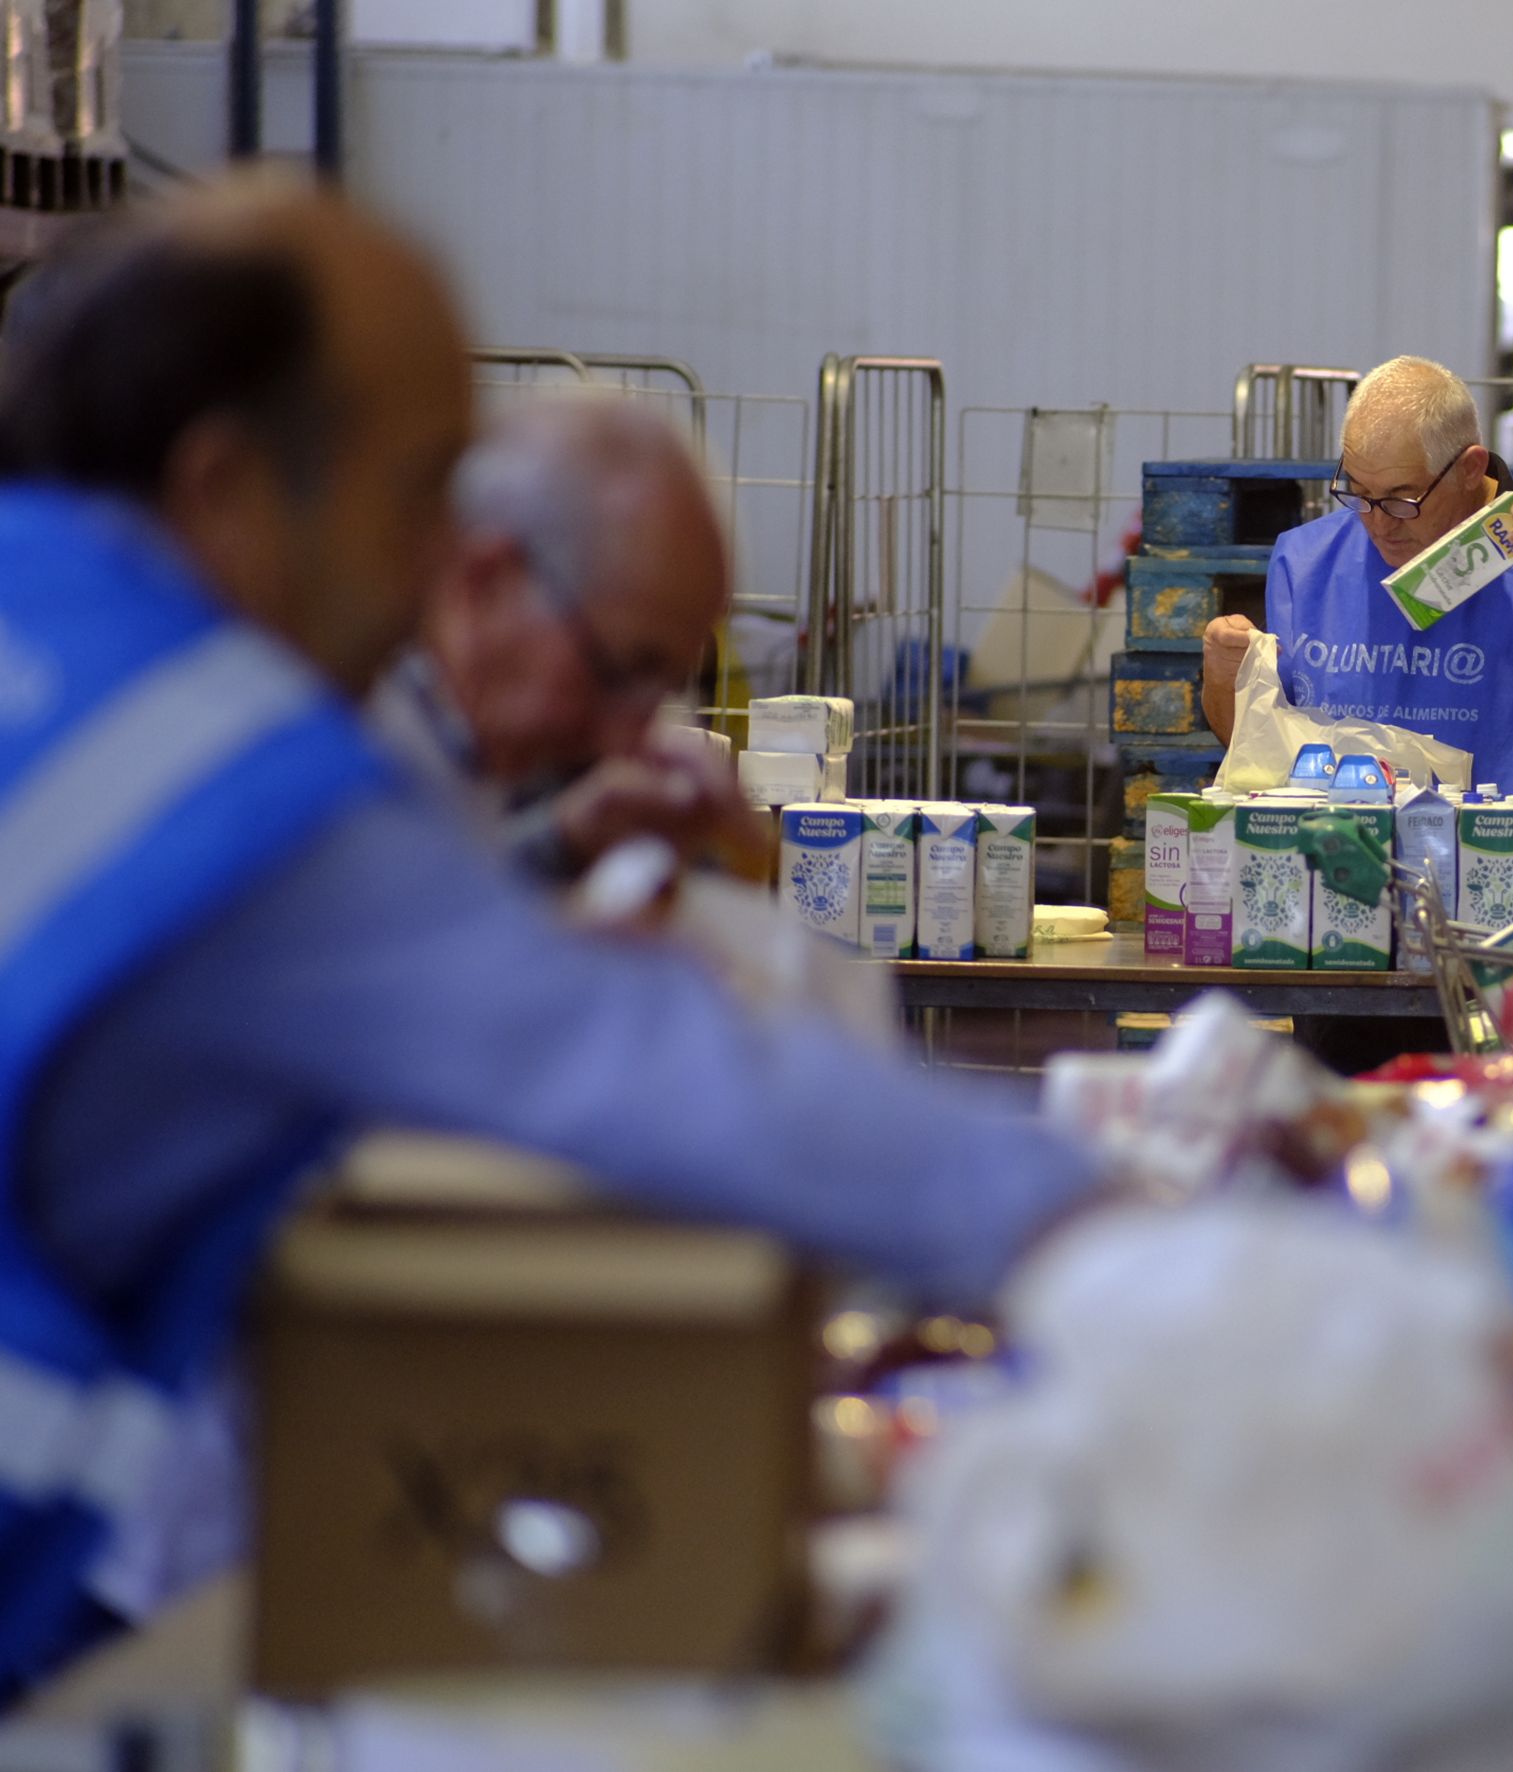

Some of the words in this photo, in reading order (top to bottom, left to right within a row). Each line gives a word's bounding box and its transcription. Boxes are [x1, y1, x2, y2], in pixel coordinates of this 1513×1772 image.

[1320, 702, 1374, 718] BANCOS
[1393, 704, 1480, 721] ALIMENTOS
[800, 815, 845, 829] Campo
[1249, 812, 1296, 824] Campo
[797, 826, 847, 838] Nuestro
[1246, 823, 1298, 835] Nuestro
[930, 844, 965, 855] Campo
[987, 843, 1022, 854] Campo
[1149, 845, 1180, 861] sin
[928, 852, 968, 862] Nuestro
[985, 852, 1024, 862] Nuestro
